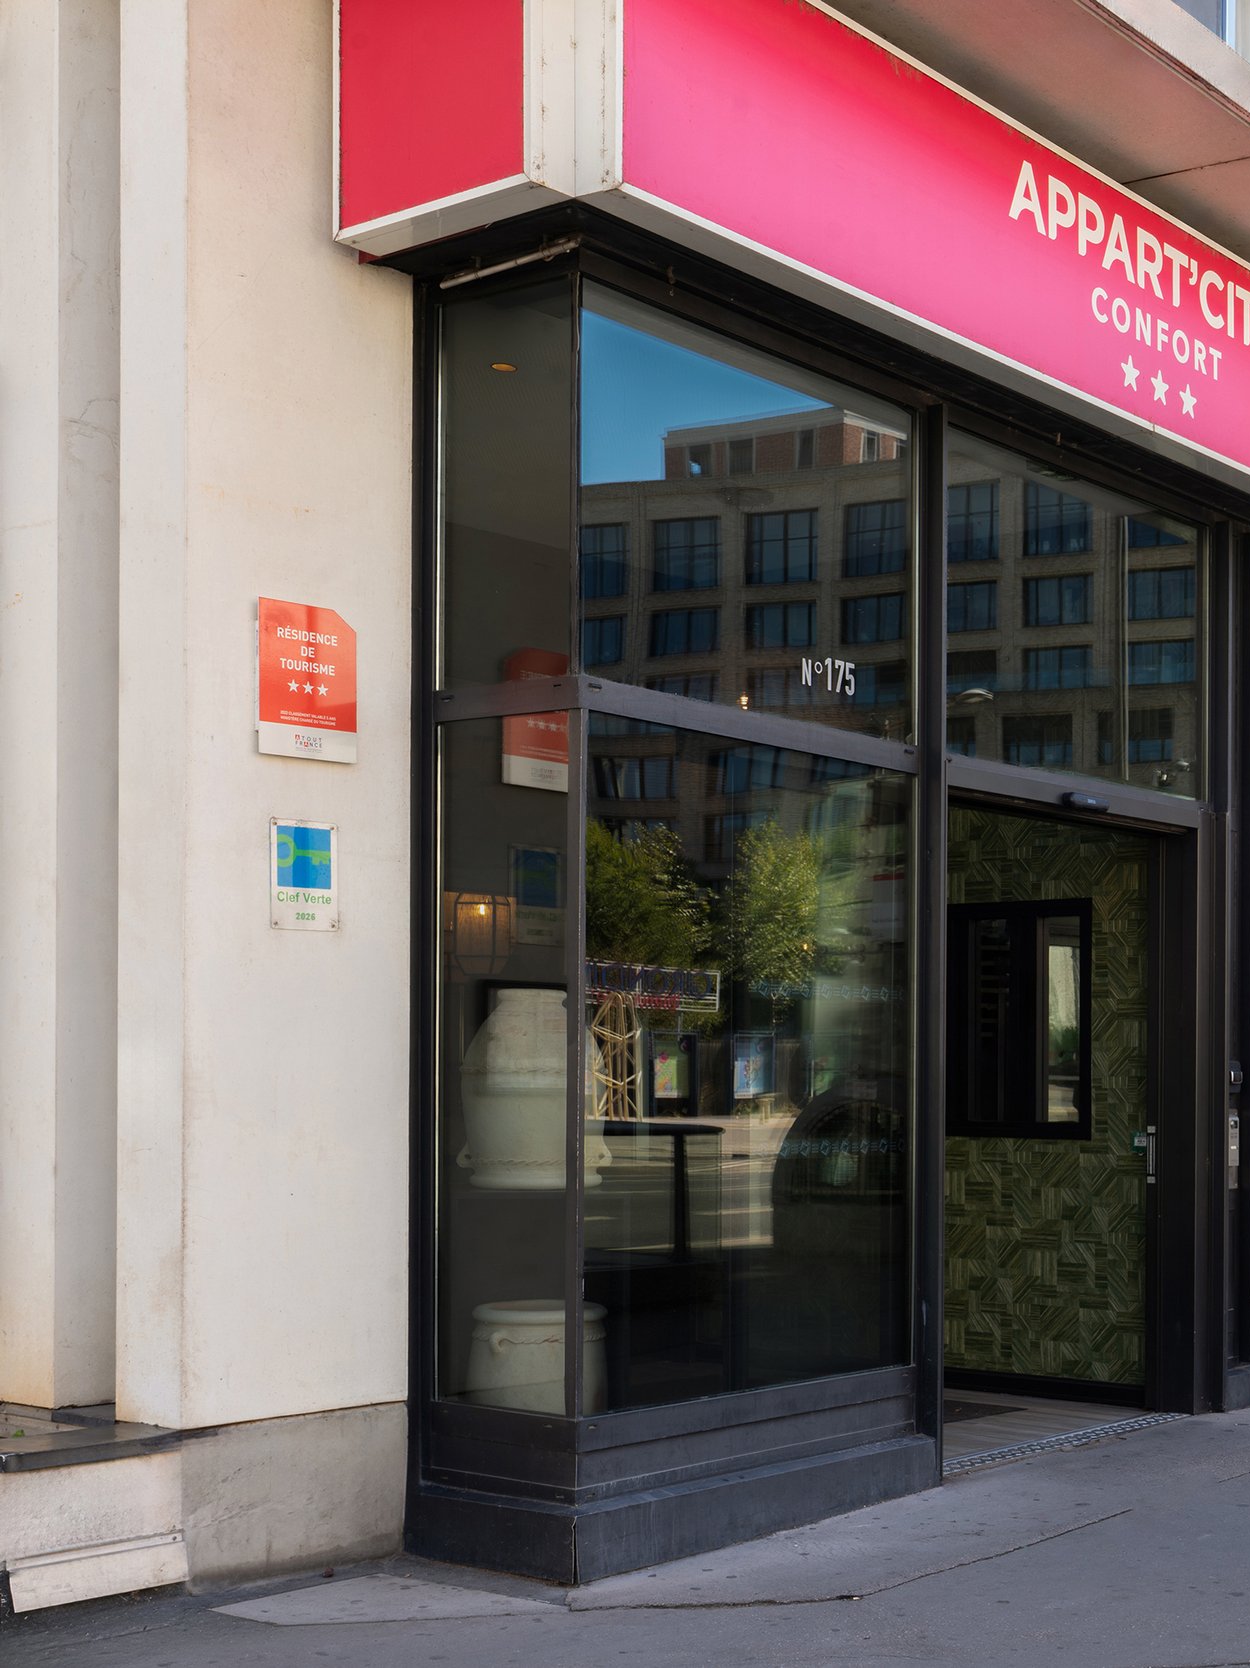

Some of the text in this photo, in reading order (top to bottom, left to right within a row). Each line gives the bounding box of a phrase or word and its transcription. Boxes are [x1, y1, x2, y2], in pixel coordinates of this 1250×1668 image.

[1091, 286, 1222, 381] CONFORT
[277, 625, 338, 647] RÉSIDENCE
[300, 645, 315, 658] DE
[280, 657, 336, 676] TOURISME
[277, 891, 332, 905] Clef Verte
